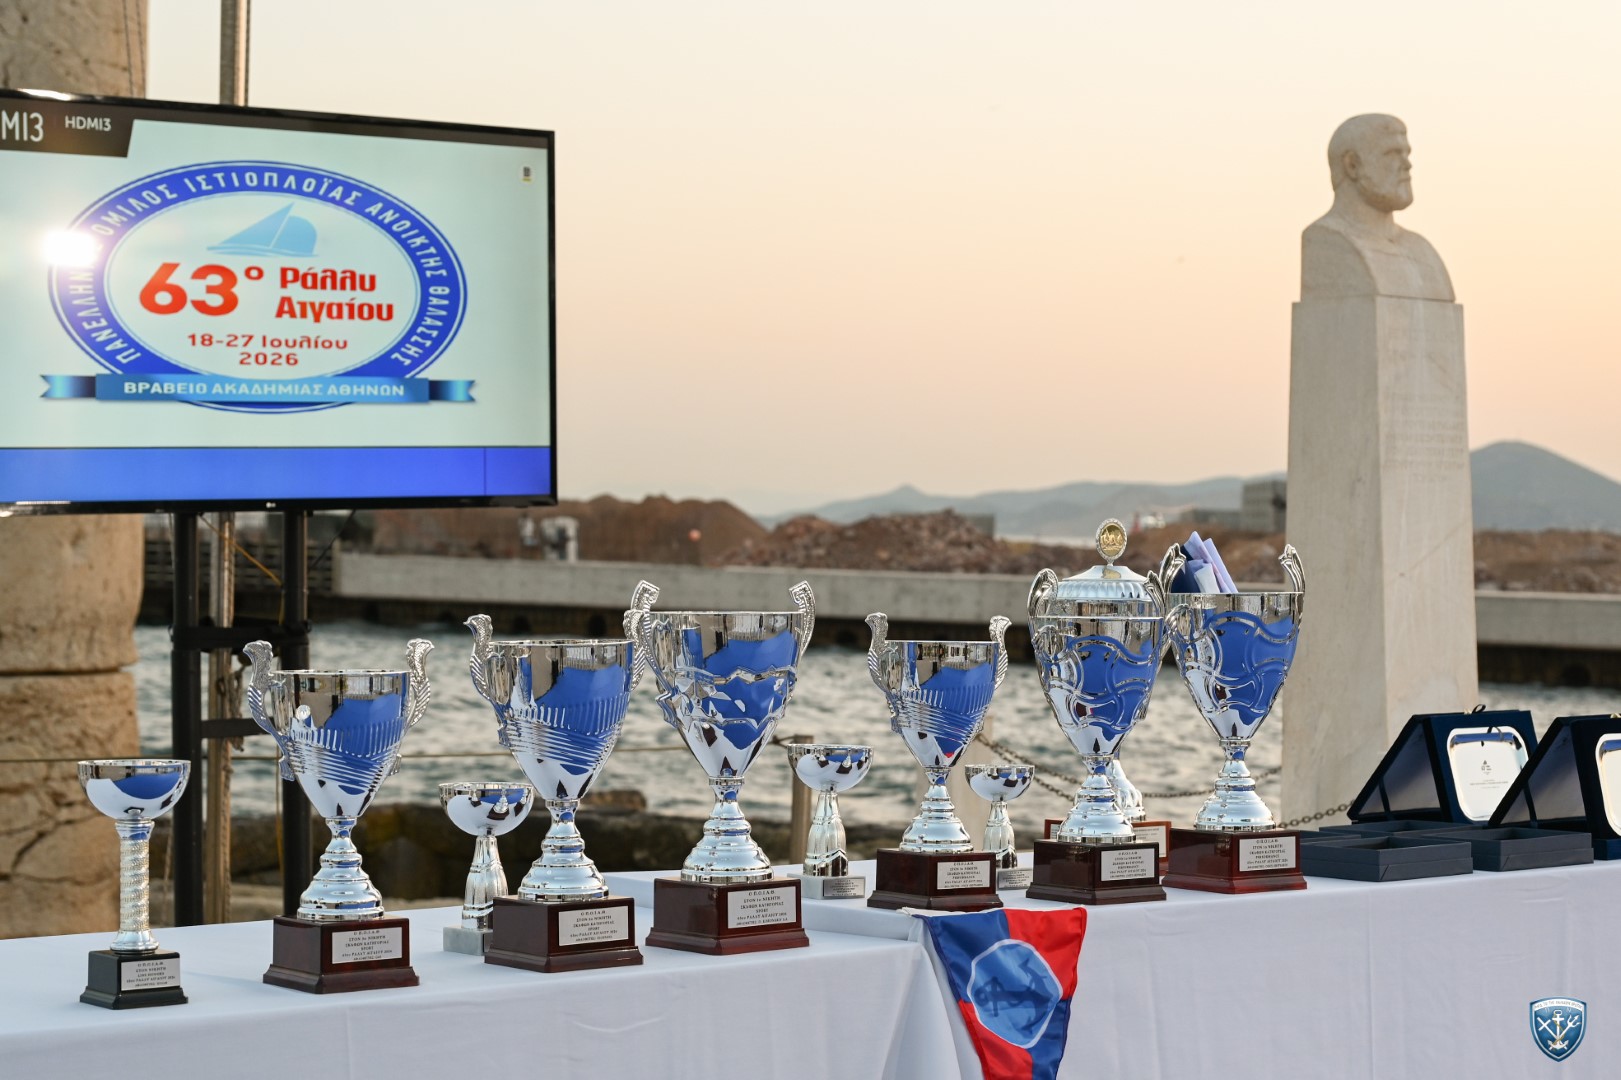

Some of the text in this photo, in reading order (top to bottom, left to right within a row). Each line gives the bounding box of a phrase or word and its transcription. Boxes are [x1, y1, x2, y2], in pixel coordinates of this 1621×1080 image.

[64, 115, 112, 132] HDMI3
[183, 171, 362, 206] ΙΣΤΙΟΠΛΟΪΑΣ
[91, 183, 178, 236] ΟΜΙΛΟΣ
[364, 202, 448, 278] ΑΝΟΙΚΤΗΣ
[280, 267, 377, 292] Ράλλυ
[274, 296, 395, 323] Αιγαίου
[390, 285, 450, 366] ΘΑΛΑΣΣΗΣ
[187, 333, 349, 350] 18-27 Ιουλίου
[238, 352, 300, 367] 2026
[122, 381, 405, 397] ΒΡΑΒΕΙΟ ΑΚΑΔΗΜΙΑΣ ΑΘΗΝΩΝ
